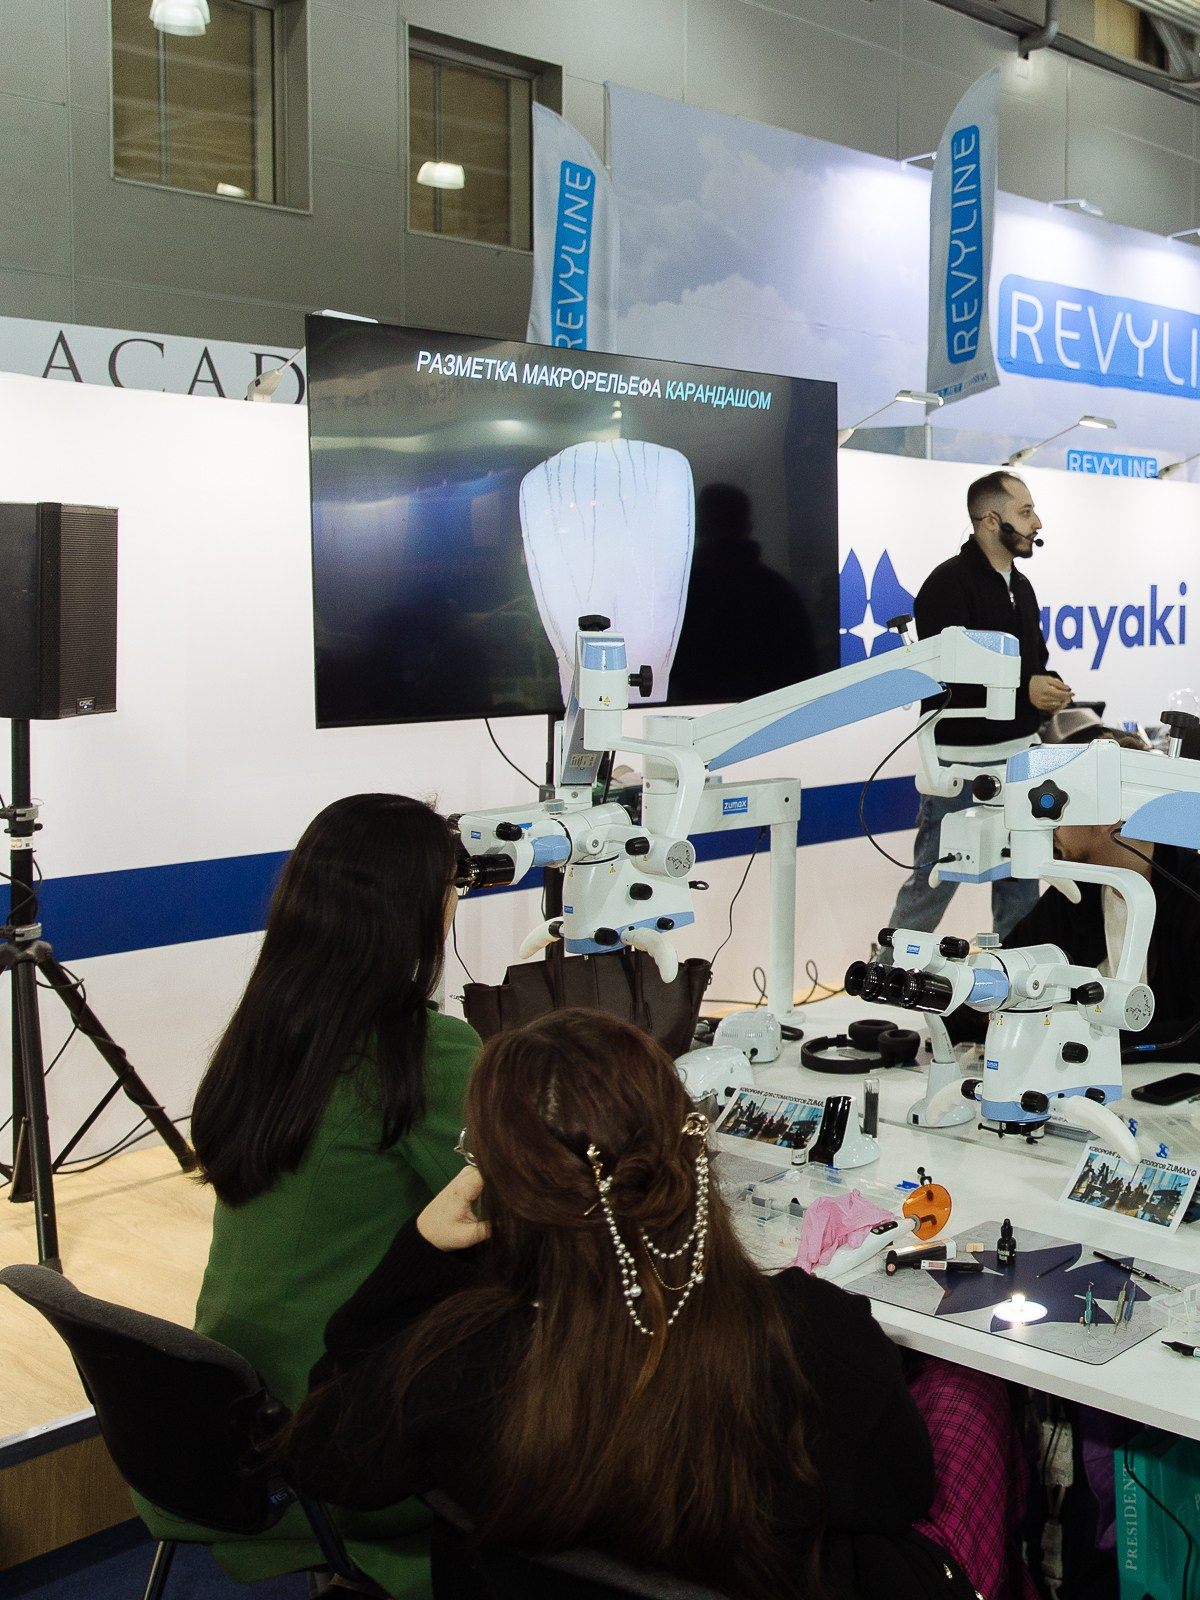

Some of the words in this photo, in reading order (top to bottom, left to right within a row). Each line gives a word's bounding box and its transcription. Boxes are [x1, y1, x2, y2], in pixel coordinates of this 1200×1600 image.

[555, 167, 592, 349] REVYLINE
[951, 133, 978, 356] REVYLINE
[416, 350, 518, 383] РАЗМЕТКА
[522, 363, 662, 398] МАКРОРЕЛЬЕФА
[665, 381, 772, 411] КАРАНДАШОМ
[1068, 452, 1156, 477] REVYLINE
[1039, 581, 1187, 671] ayaki
[723, 800, 747, 811] zumax
[1140, 1158, 1166, 1171] АТОЛОГОВ
[1166, 1163, 1192, 1176] ZUMAX
[1122, 1464, 1138, 1571] PRESIDENT
